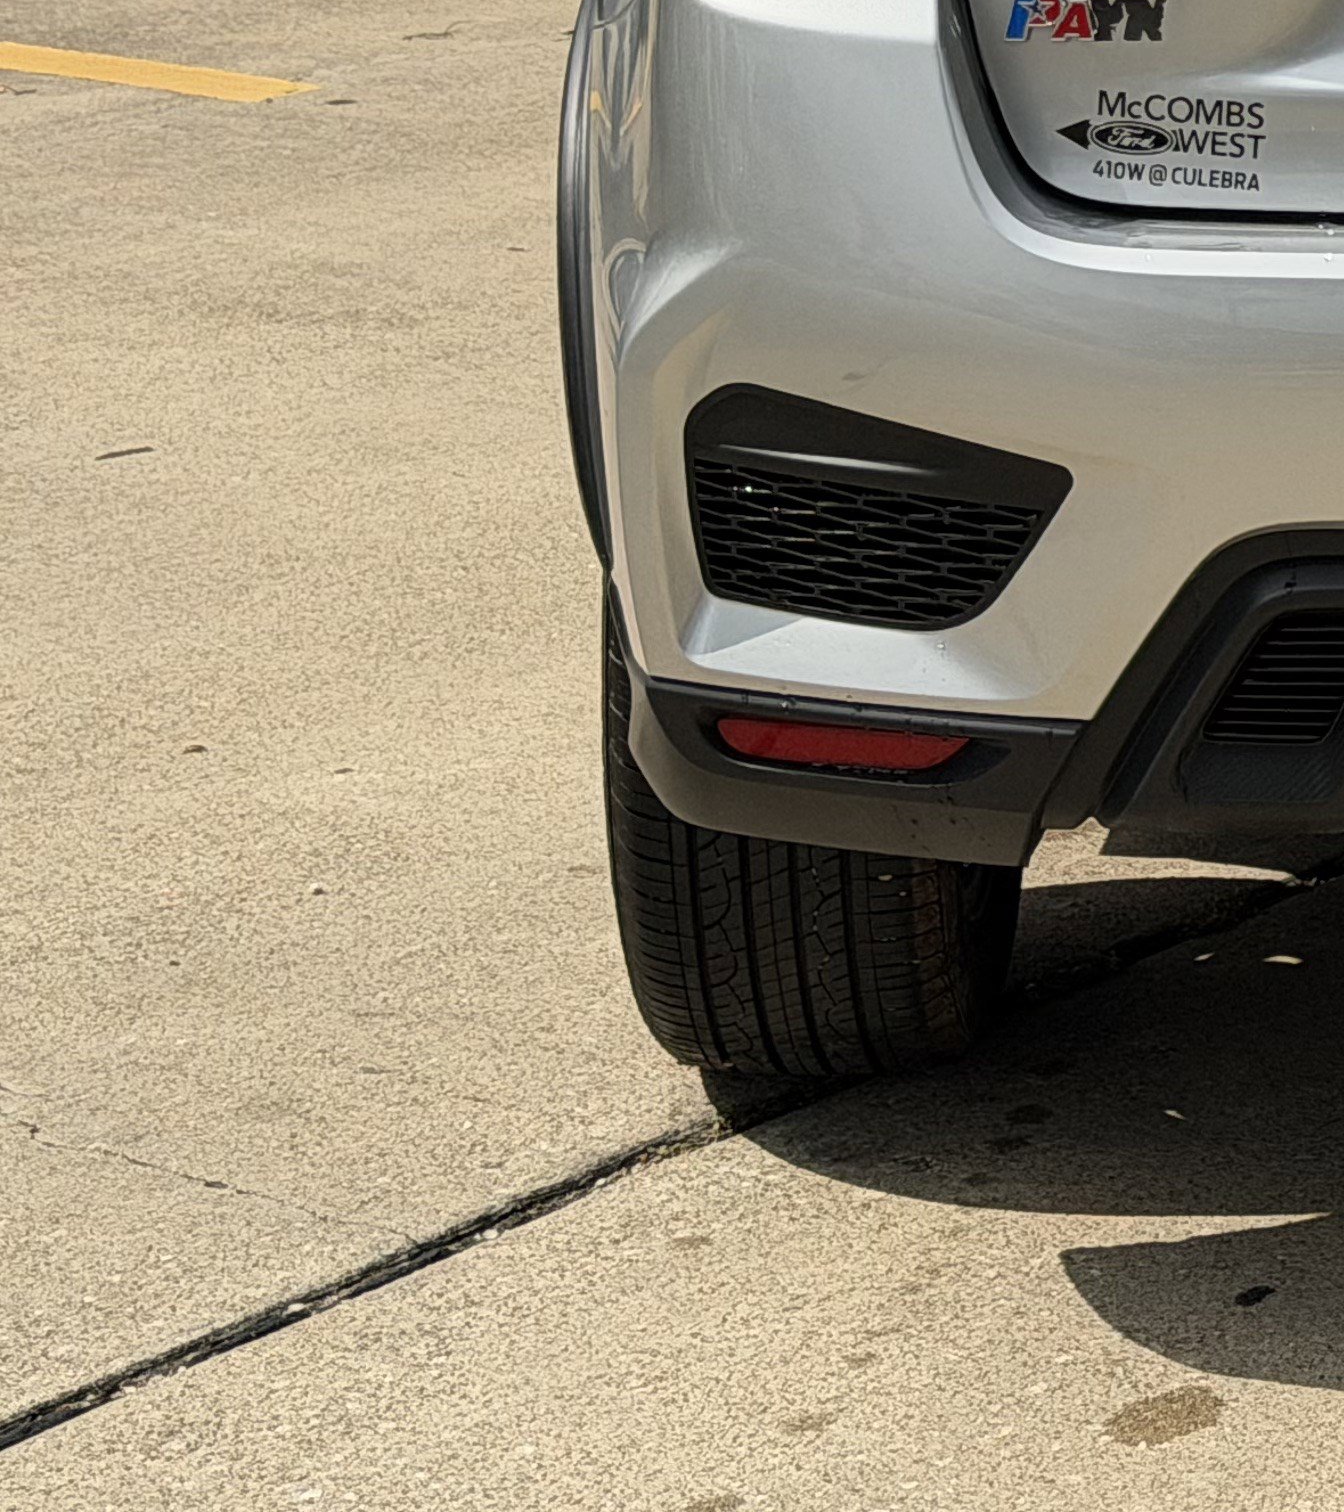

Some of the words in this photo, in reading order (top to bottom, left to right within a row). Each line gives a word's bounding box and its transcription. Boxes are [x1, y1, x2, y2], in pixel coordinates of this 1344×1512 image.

[1098, 90, 1265, 130] McCOMBS
[1178, 129, 1267, 160] WEST
[1092, 159, 1146, 183] 410W
[1171, 166, 1260, 192] CULEBRA
